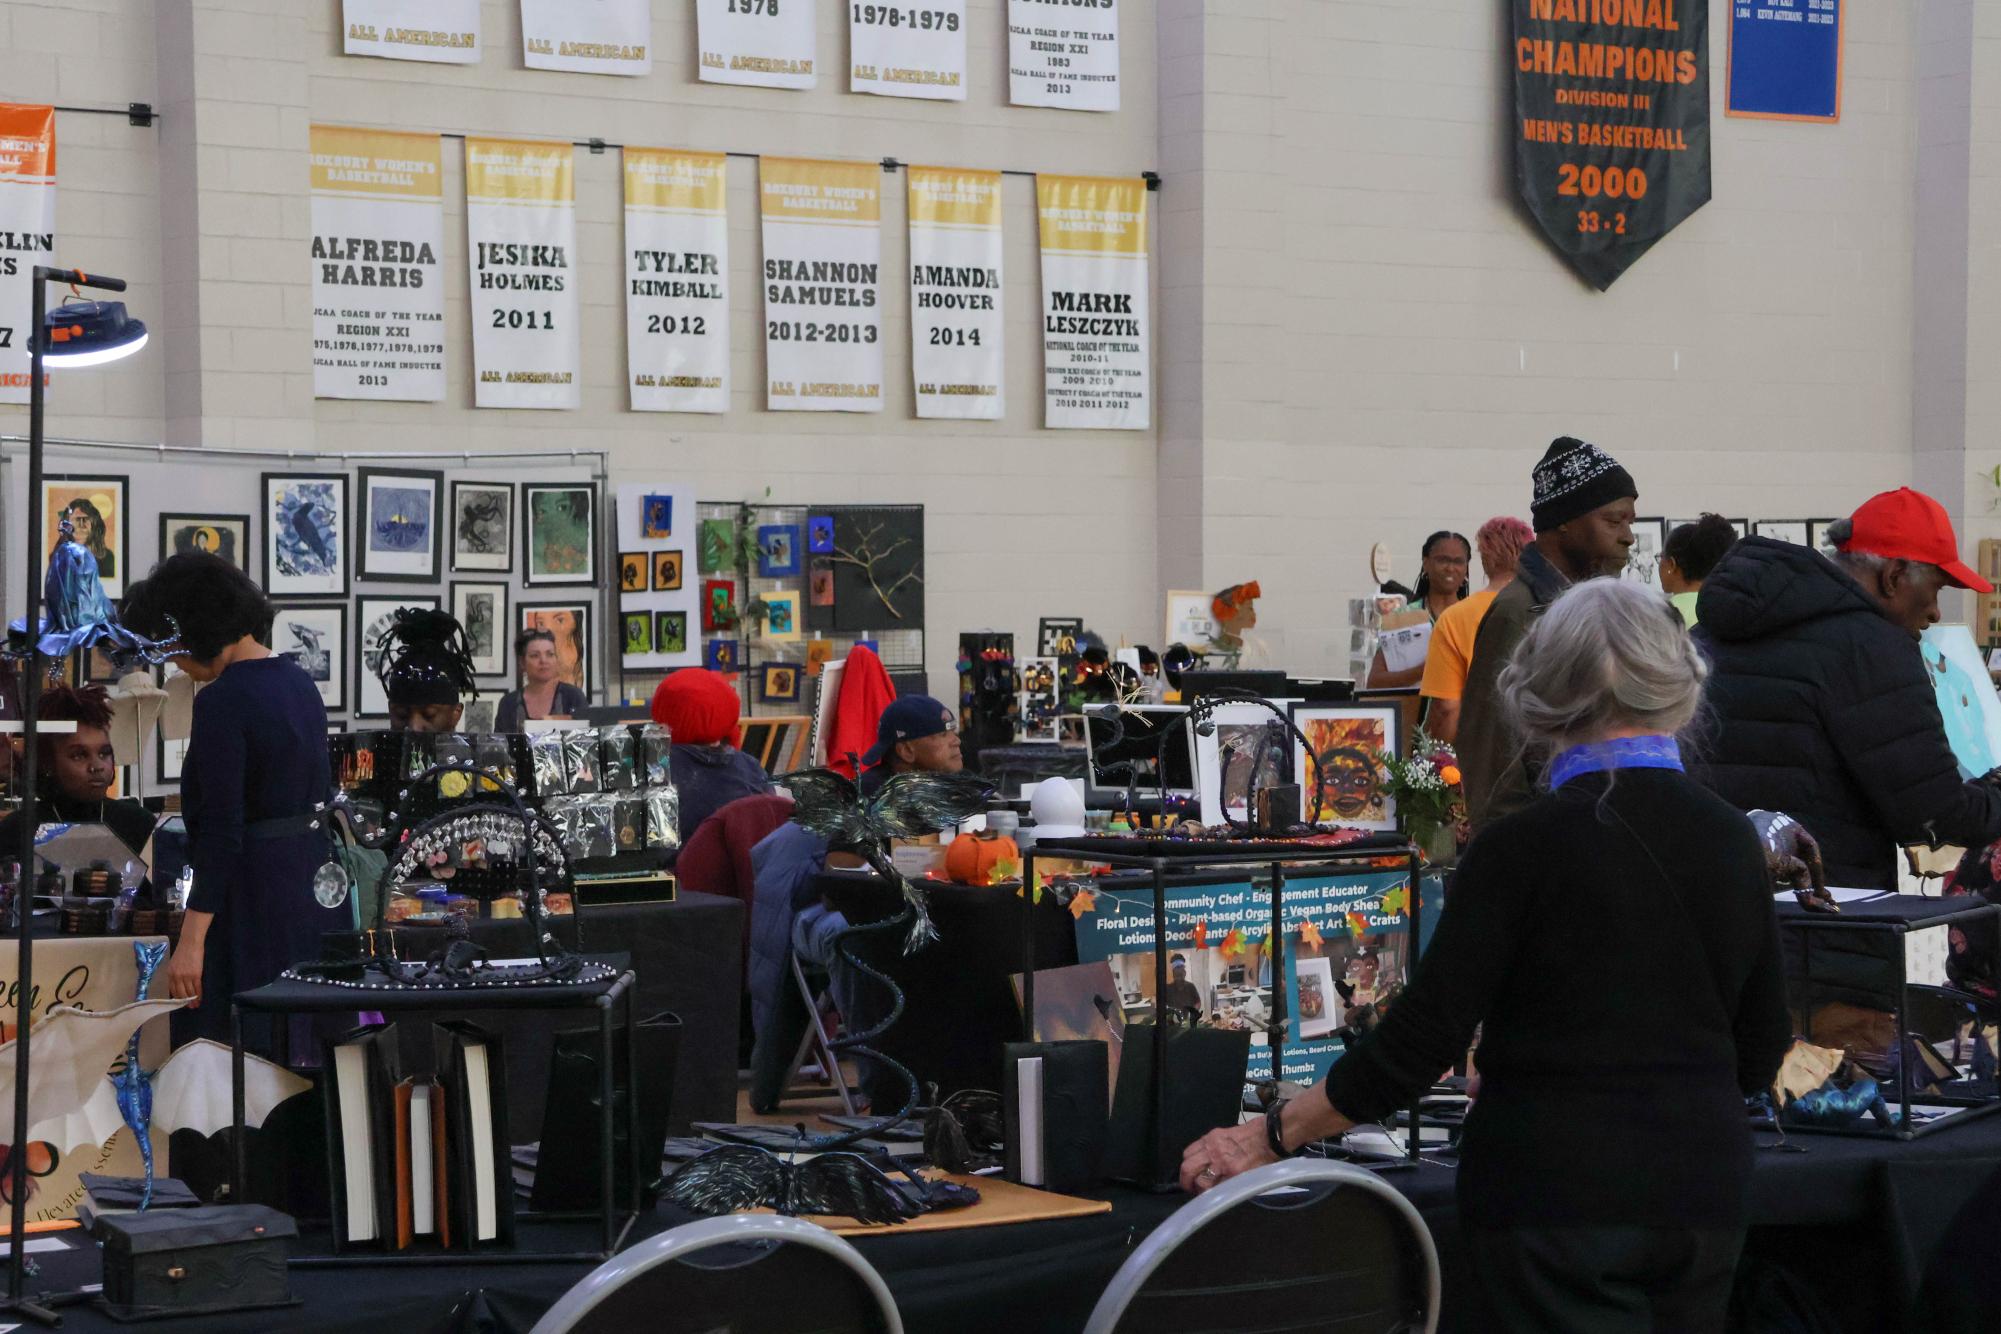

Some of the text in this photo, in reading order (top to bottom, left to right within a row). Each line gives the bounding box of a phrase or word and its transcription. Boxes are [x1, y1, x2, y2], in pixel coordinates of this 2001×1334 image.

[728, 0, 779, 16] 1978
[854, 4, 960, 31] 1978-1979
[1530, 0, 1680, 31] NATIONAL
[350, 24, 475, 48] ALL AMERICAN
[1034, 28, 1058, 37] COACH
[1060, 30, 1071, 38] OF
[1073, 31, 1088, 39] THE
[1092, 33, 1115, 41] YEAR
[528, 38, 646, 60] ALL AMERICAN
[1030, 40, 1088, 54] REGION XXI
[702, 52, 813, 74] ALL AMERICAN
[1516, 37, 1697, 85] CHAMPIONS
[854, 65, 961, 86] ALL AMERICAN
[1046, 83, 1071, 94] 2013
[1556, 88, 1650, 110] DIVISION III
[1523, 118, 1688, 151] MEN'S BASKETBALL
[1557, 163, 1648, 200] 2000
[1577, 211, 1600, 233] 33
[1614, 212, 1626, 234] 2
[312, 236, 436, 264] ALFREDA
[478, 242, 568, 270] JESIKA
[635, 250, 719, 275] TYLER
[766, 259, 878, 284] SHANNON
[322, 264, 423, 288] HARRIS
[480, 272, 565, 291] HOLMES
[913, 265, 999, 288] AMANDA
[632, 279, 723, 299] KIMBALL
[769, 284, 876, 307] SAMUELS
[918, 292, 994, 310] HOOVER
[1052, 291, 1132, 313] MARK
[341, 310, 370, 318] COACH
[375, 311, 387, 319] OF
[392, 312, 411, 320] THE
[415, 313, 443, 321] YEAR
[492, 308, 555, 330] 2011
[647, 314, 706, 335] 2012
[1047, 316, 1140, 336] LESZCZYK
[337, 324, 410, 337] REGION XXI
[769, 321, 878, 343] 2012-2013
[930, 327, 981, 346] 2014
[373, 361, 396, 369] FAME
[358, 375, 388, 386] 2013
[1062, 376, 1085, 384] 2009
[1079, 399, 1102, 408] 2011
[1106, 400, 1129, 409] 2012
[1154, 894, 1216, 910] ommunity
[1218, 893, 1244, 906] Chef
[1253, 887, 1320, 904] Enggement
[1322, 885, 1368, 898] Educator
[1097, 916, 1128, 930] Floral
[1130, 914, 1168, 930] Desin
[1179, 908, 1243, 925] Plant-based
[1246, 907, 1286, 923] Orgac
[1289, 903, 1322, 917] Vegan
[1325, 899, 1350, 914] Body
[1353, 898, 1380, 911] Shea
[1165, 927, 1227, 941] Deodants
[1241, 922, 1273, 937] Arcyli
[1281, 920, 1324, 934] Absct
[1326, 918, 1343, 930] Art
[1370, 914, 1401, 927] Crafts
